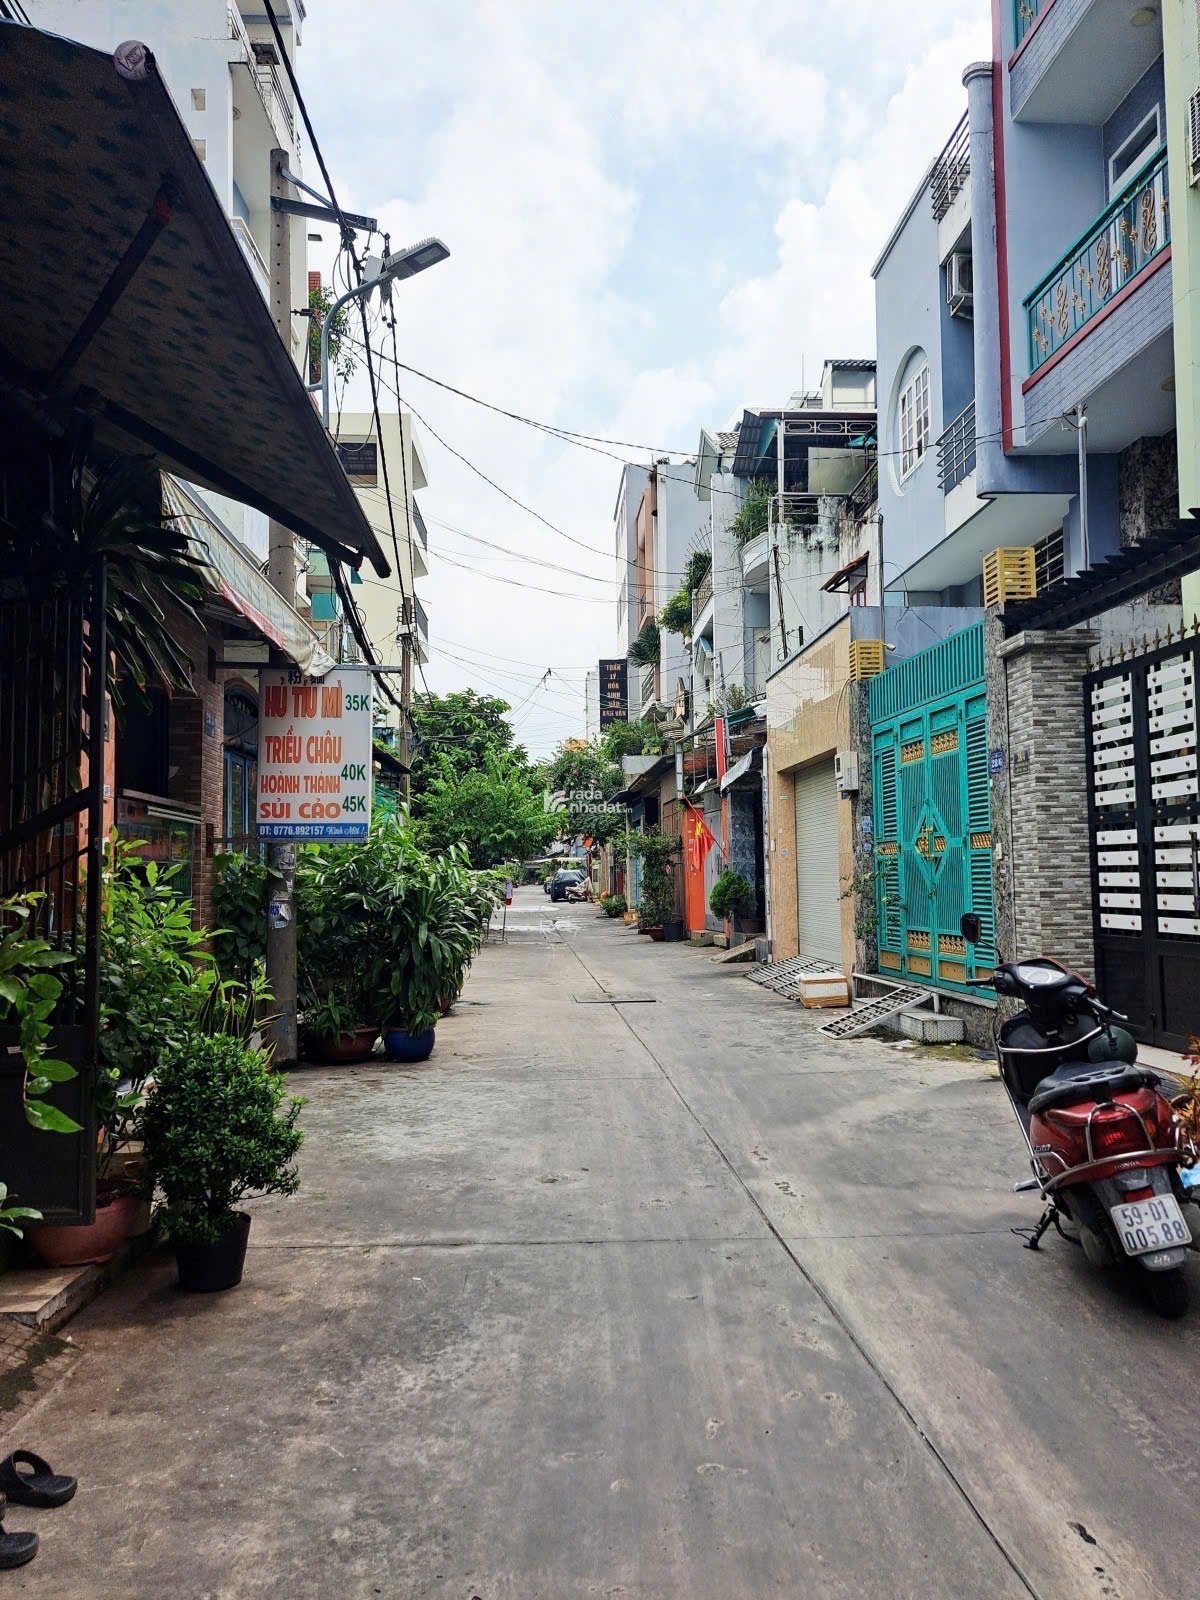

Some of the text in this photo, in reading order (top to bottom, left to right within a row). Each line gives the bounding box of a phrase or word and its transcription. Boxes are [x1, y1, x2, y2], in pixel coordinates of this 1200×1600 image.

[345, 694, 370, 711] 35K
[306, 730, 342, 764] CHÂU
[260, 770, 300, 793] HOÀNH
[341, 764, 366, 780] 40K
[260, 797, 341, 819] SỦI CẢO
[342, 795, 366, 812] 45K
[273, 826, 324, 836] 0776.892157
[1124, 1220, 1185, 1249] 005.88
